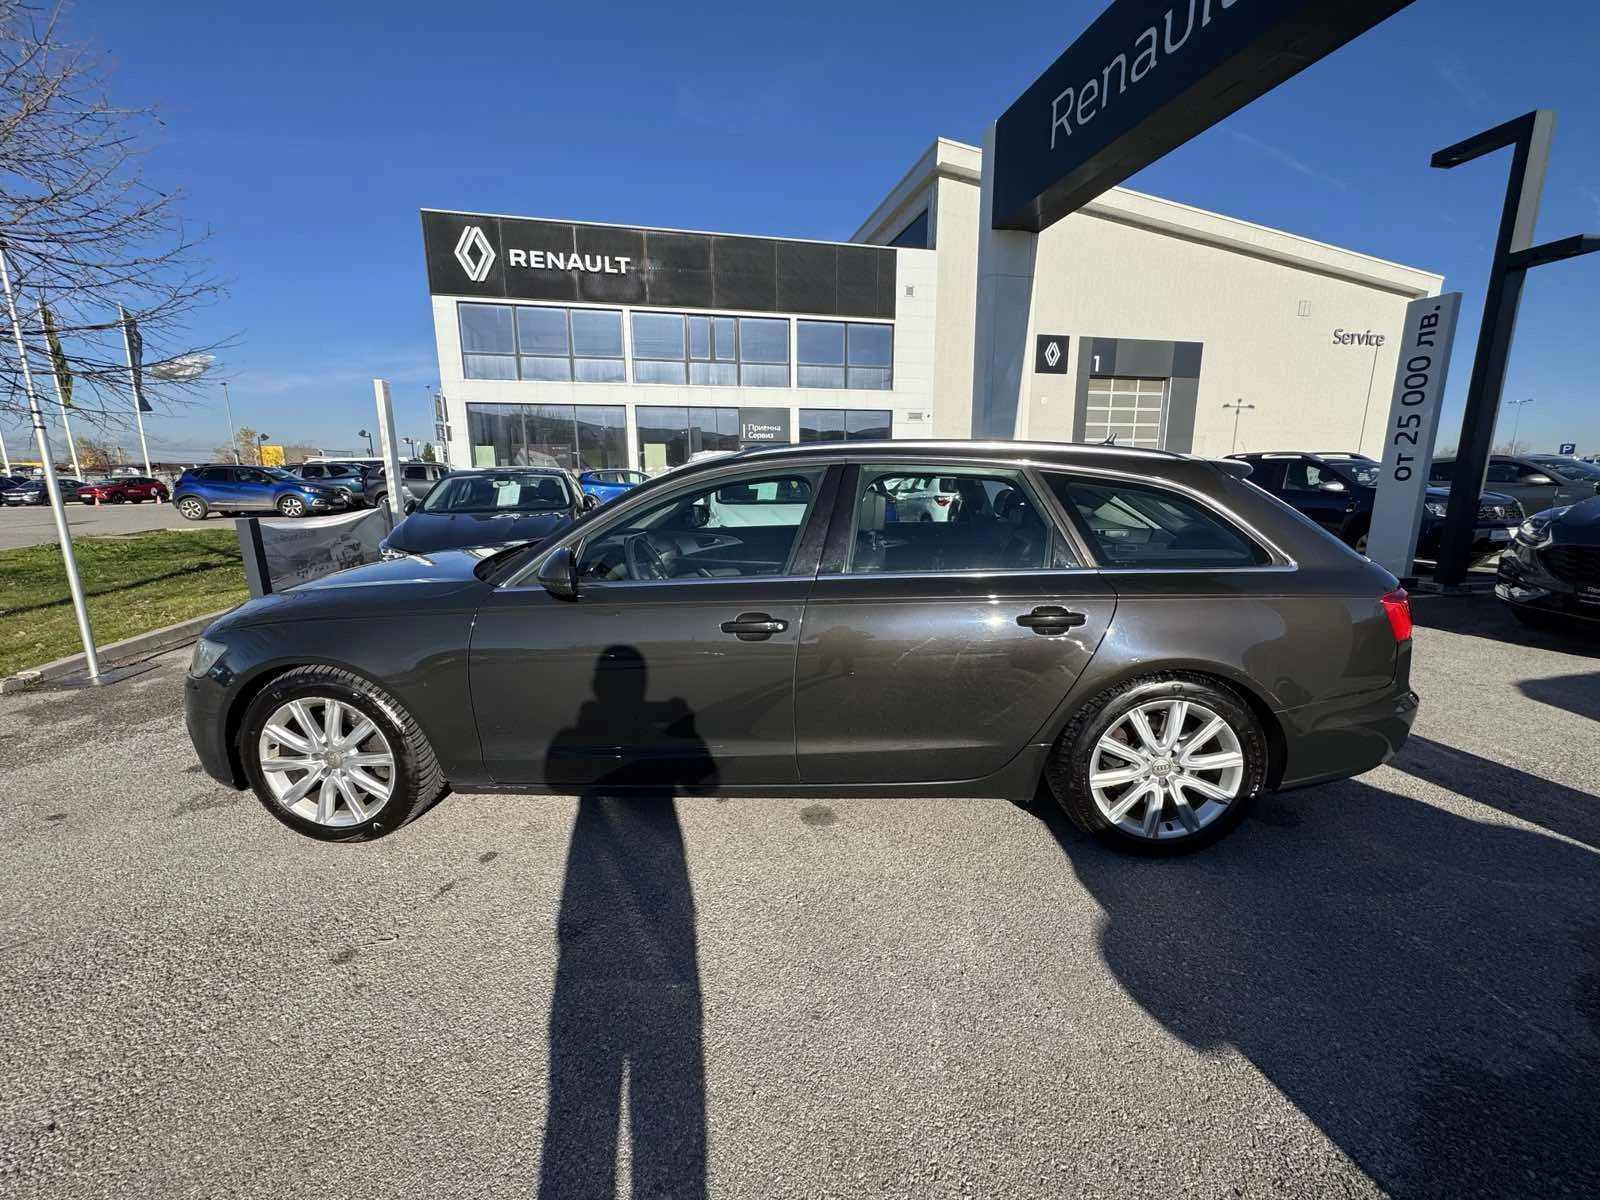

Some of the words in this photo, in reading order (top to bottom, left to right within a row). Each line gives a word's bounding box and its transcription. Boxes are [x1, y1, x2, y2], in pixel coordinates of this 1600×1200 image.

[1050, 0, 1237, 150] Renau
[508, 248, 631, 275] RENAULT
[1332, 328, 1385, 347] Service
[1415, 304, 1441, 348] лв.
[1093, 355, 1100, 372] 1
[1401, 355, 1432, 407] 000
[748, 431, 774, 440] Сервиз
[1394, 413, 1422, 446] 25
[1562, 445, 1573, 453] P
[1394, 453, 1415, 482] от
